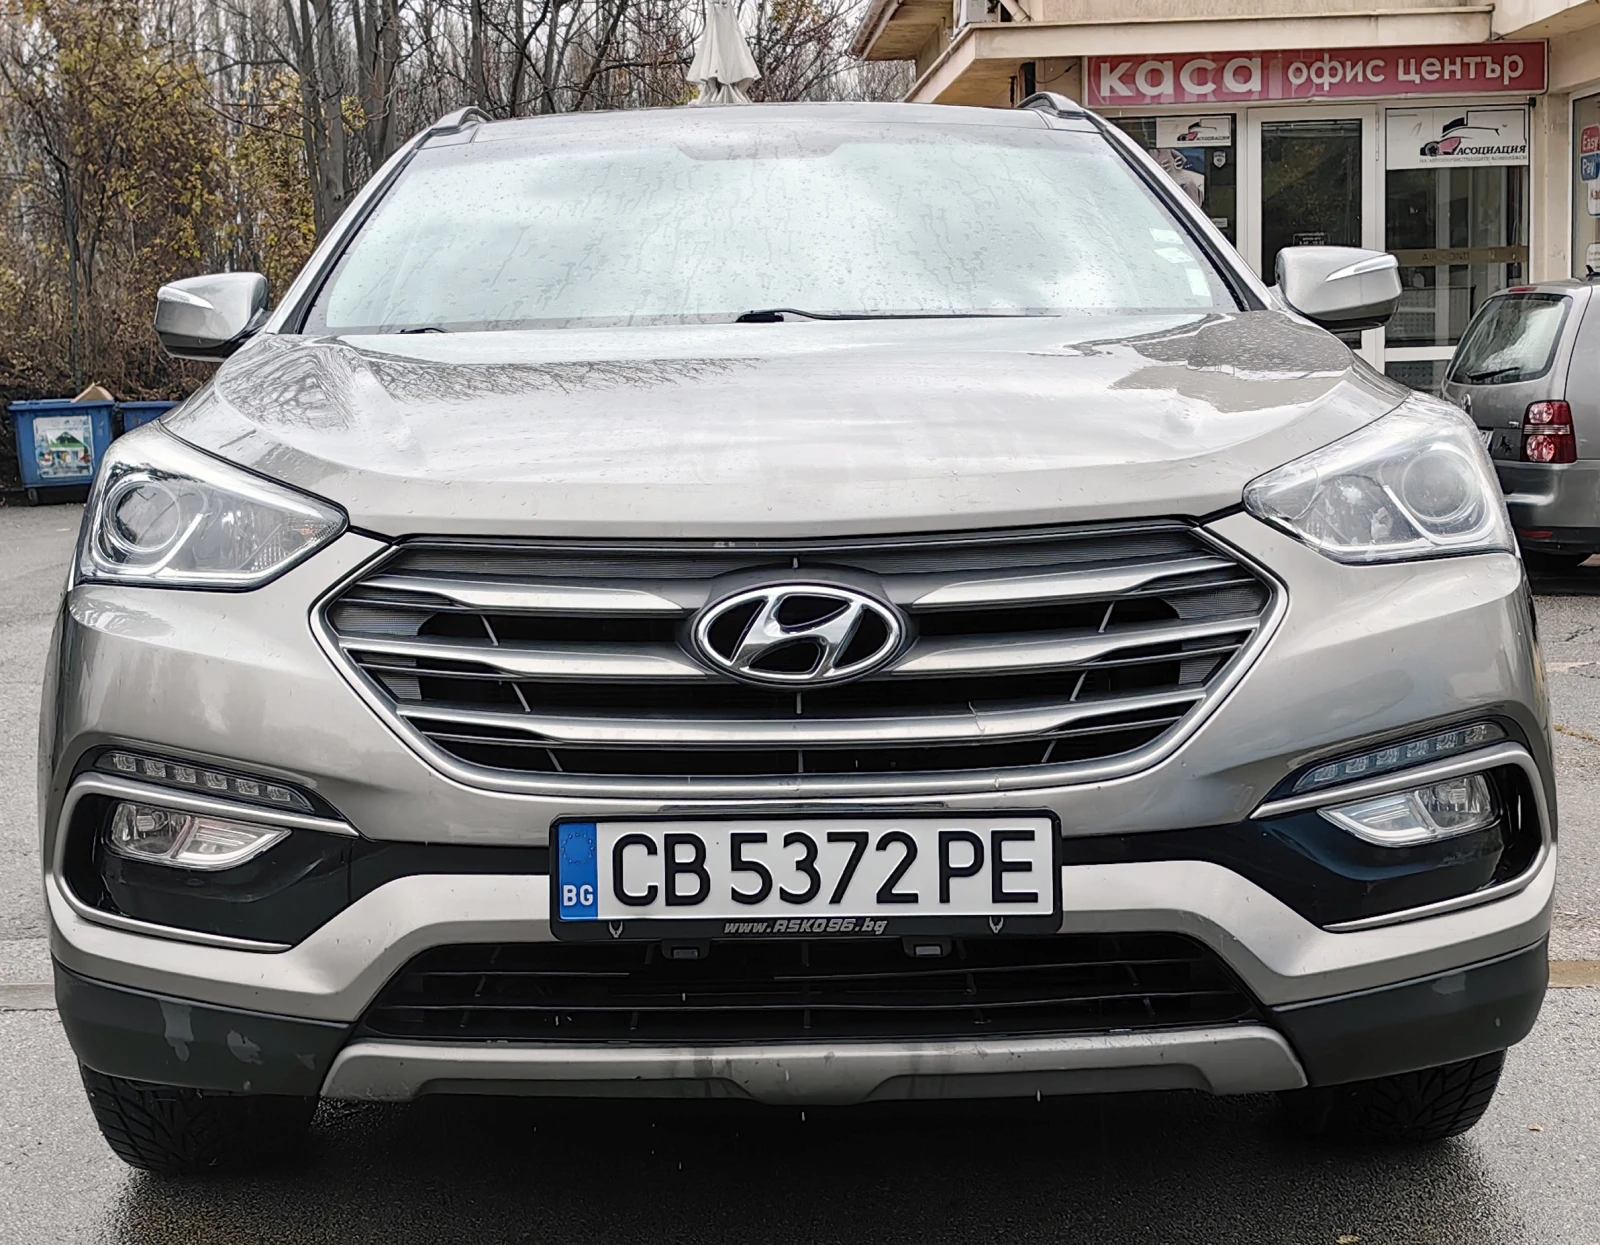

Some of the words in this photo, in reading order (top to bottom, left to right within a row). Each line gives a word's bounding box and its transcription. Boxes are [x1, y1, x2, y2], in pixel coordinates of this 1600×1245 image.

[1100, 57, 1262, 97] каса
[1287, 52, 1386, 91] офис
[1397, 54, 1524, 85] център
[1457, 144, 1527, 156] АСОЦИАЦИЯ
[1582, 158, 1595, 176] Pay
[612, 833, 711, 907] CB
[730, 831, 919, 905] 5372
[938, 830, 1039, 903] PE
[562, 885, 594, 906] BG
